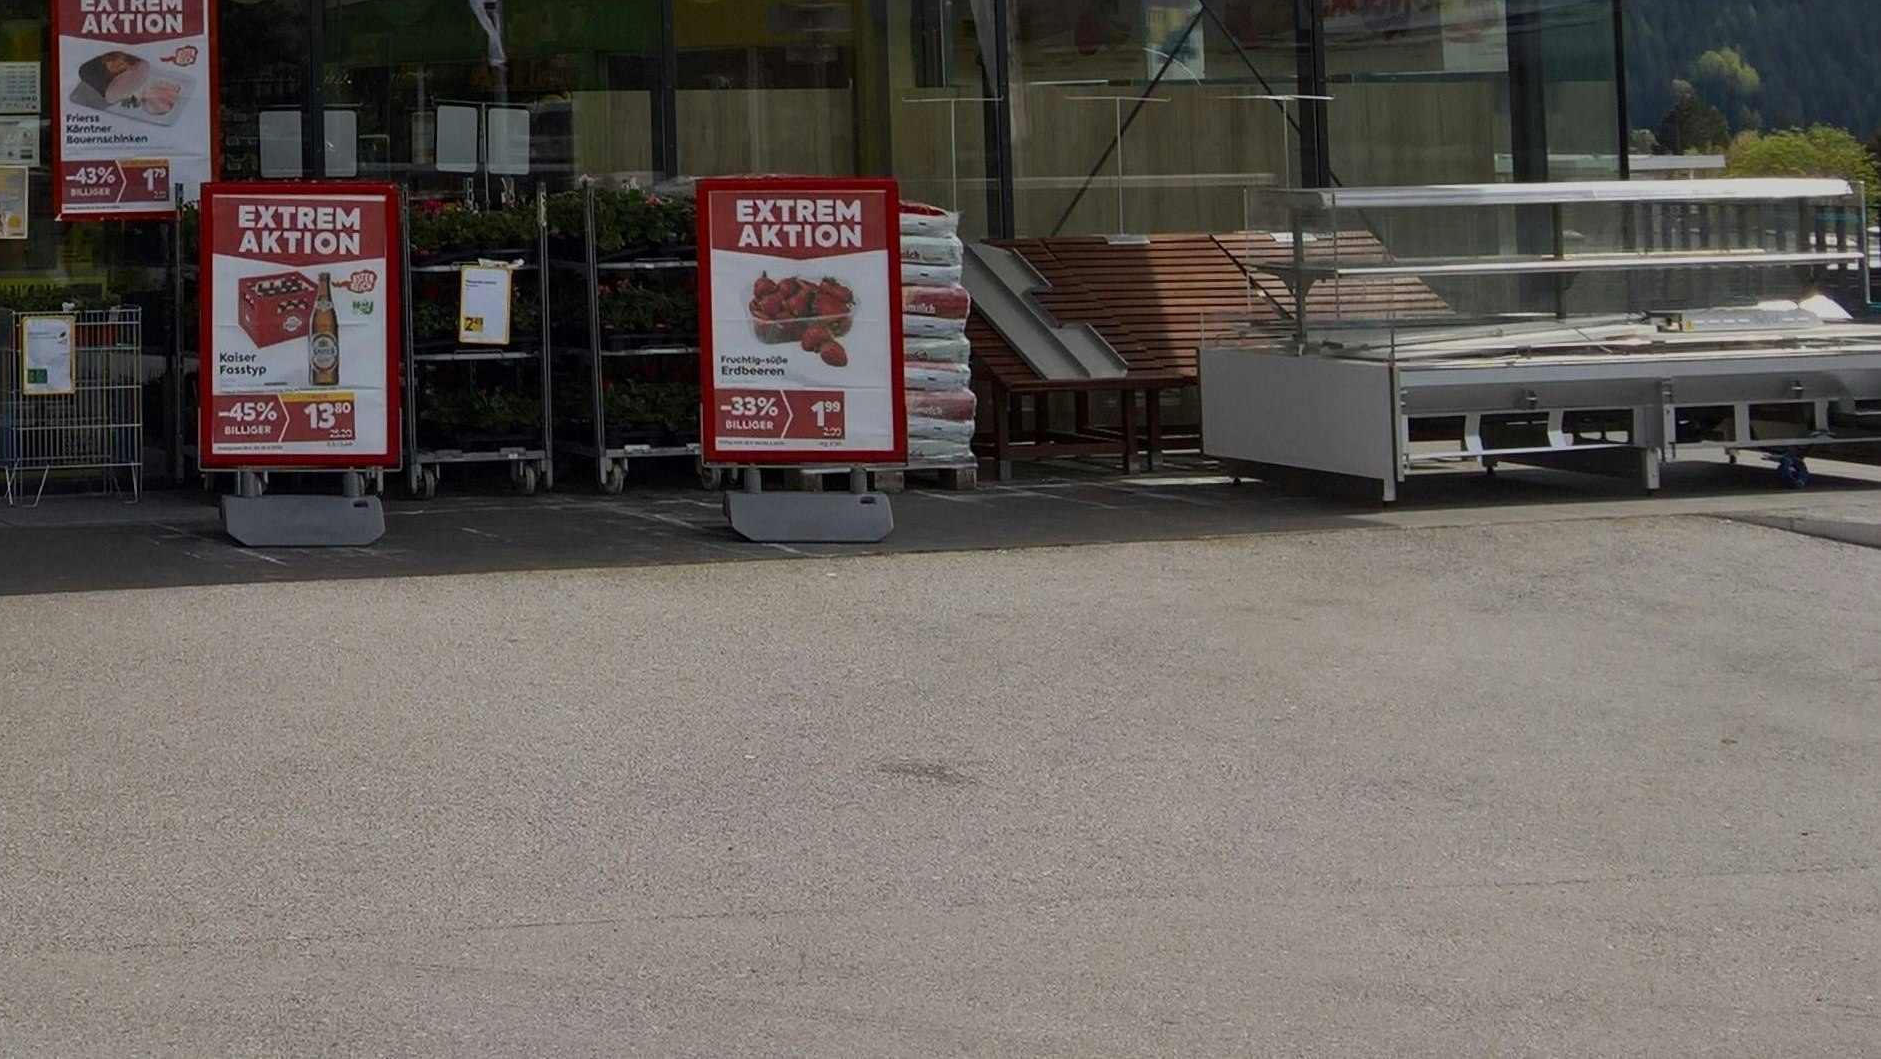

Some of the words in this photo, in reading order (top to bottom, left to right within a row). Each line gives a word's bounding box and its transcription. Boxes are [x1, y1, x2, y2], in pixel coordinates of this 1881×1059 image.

[81, 13, 184, 34] AKTION
[66, 114, 100, 123] Frierss
[66, 133, 148, 144] Bauernschinken
[70, 188, 111, 197] BILLIGER
[736, 199, 862, 223] EXTREM
[238, 205, 361, 230] EXTREM
[738, 224, 863, 248] AKTION
[238, 230, 361, 255] AKTION
[219, 352, 257, 363] Kaiser
[721, 355, 788, 366] Fruchtig-süße
[220, 365, 267, 376] Fasstyp
[722, 366, 785, 376] Erdbeeren
[218, 402, 277, 421] -45%
[720, 396, 778, 417] -33%
[224, 425, 271, 435] BILLIGER
[725, 420, 774, 430] BILLIGER
